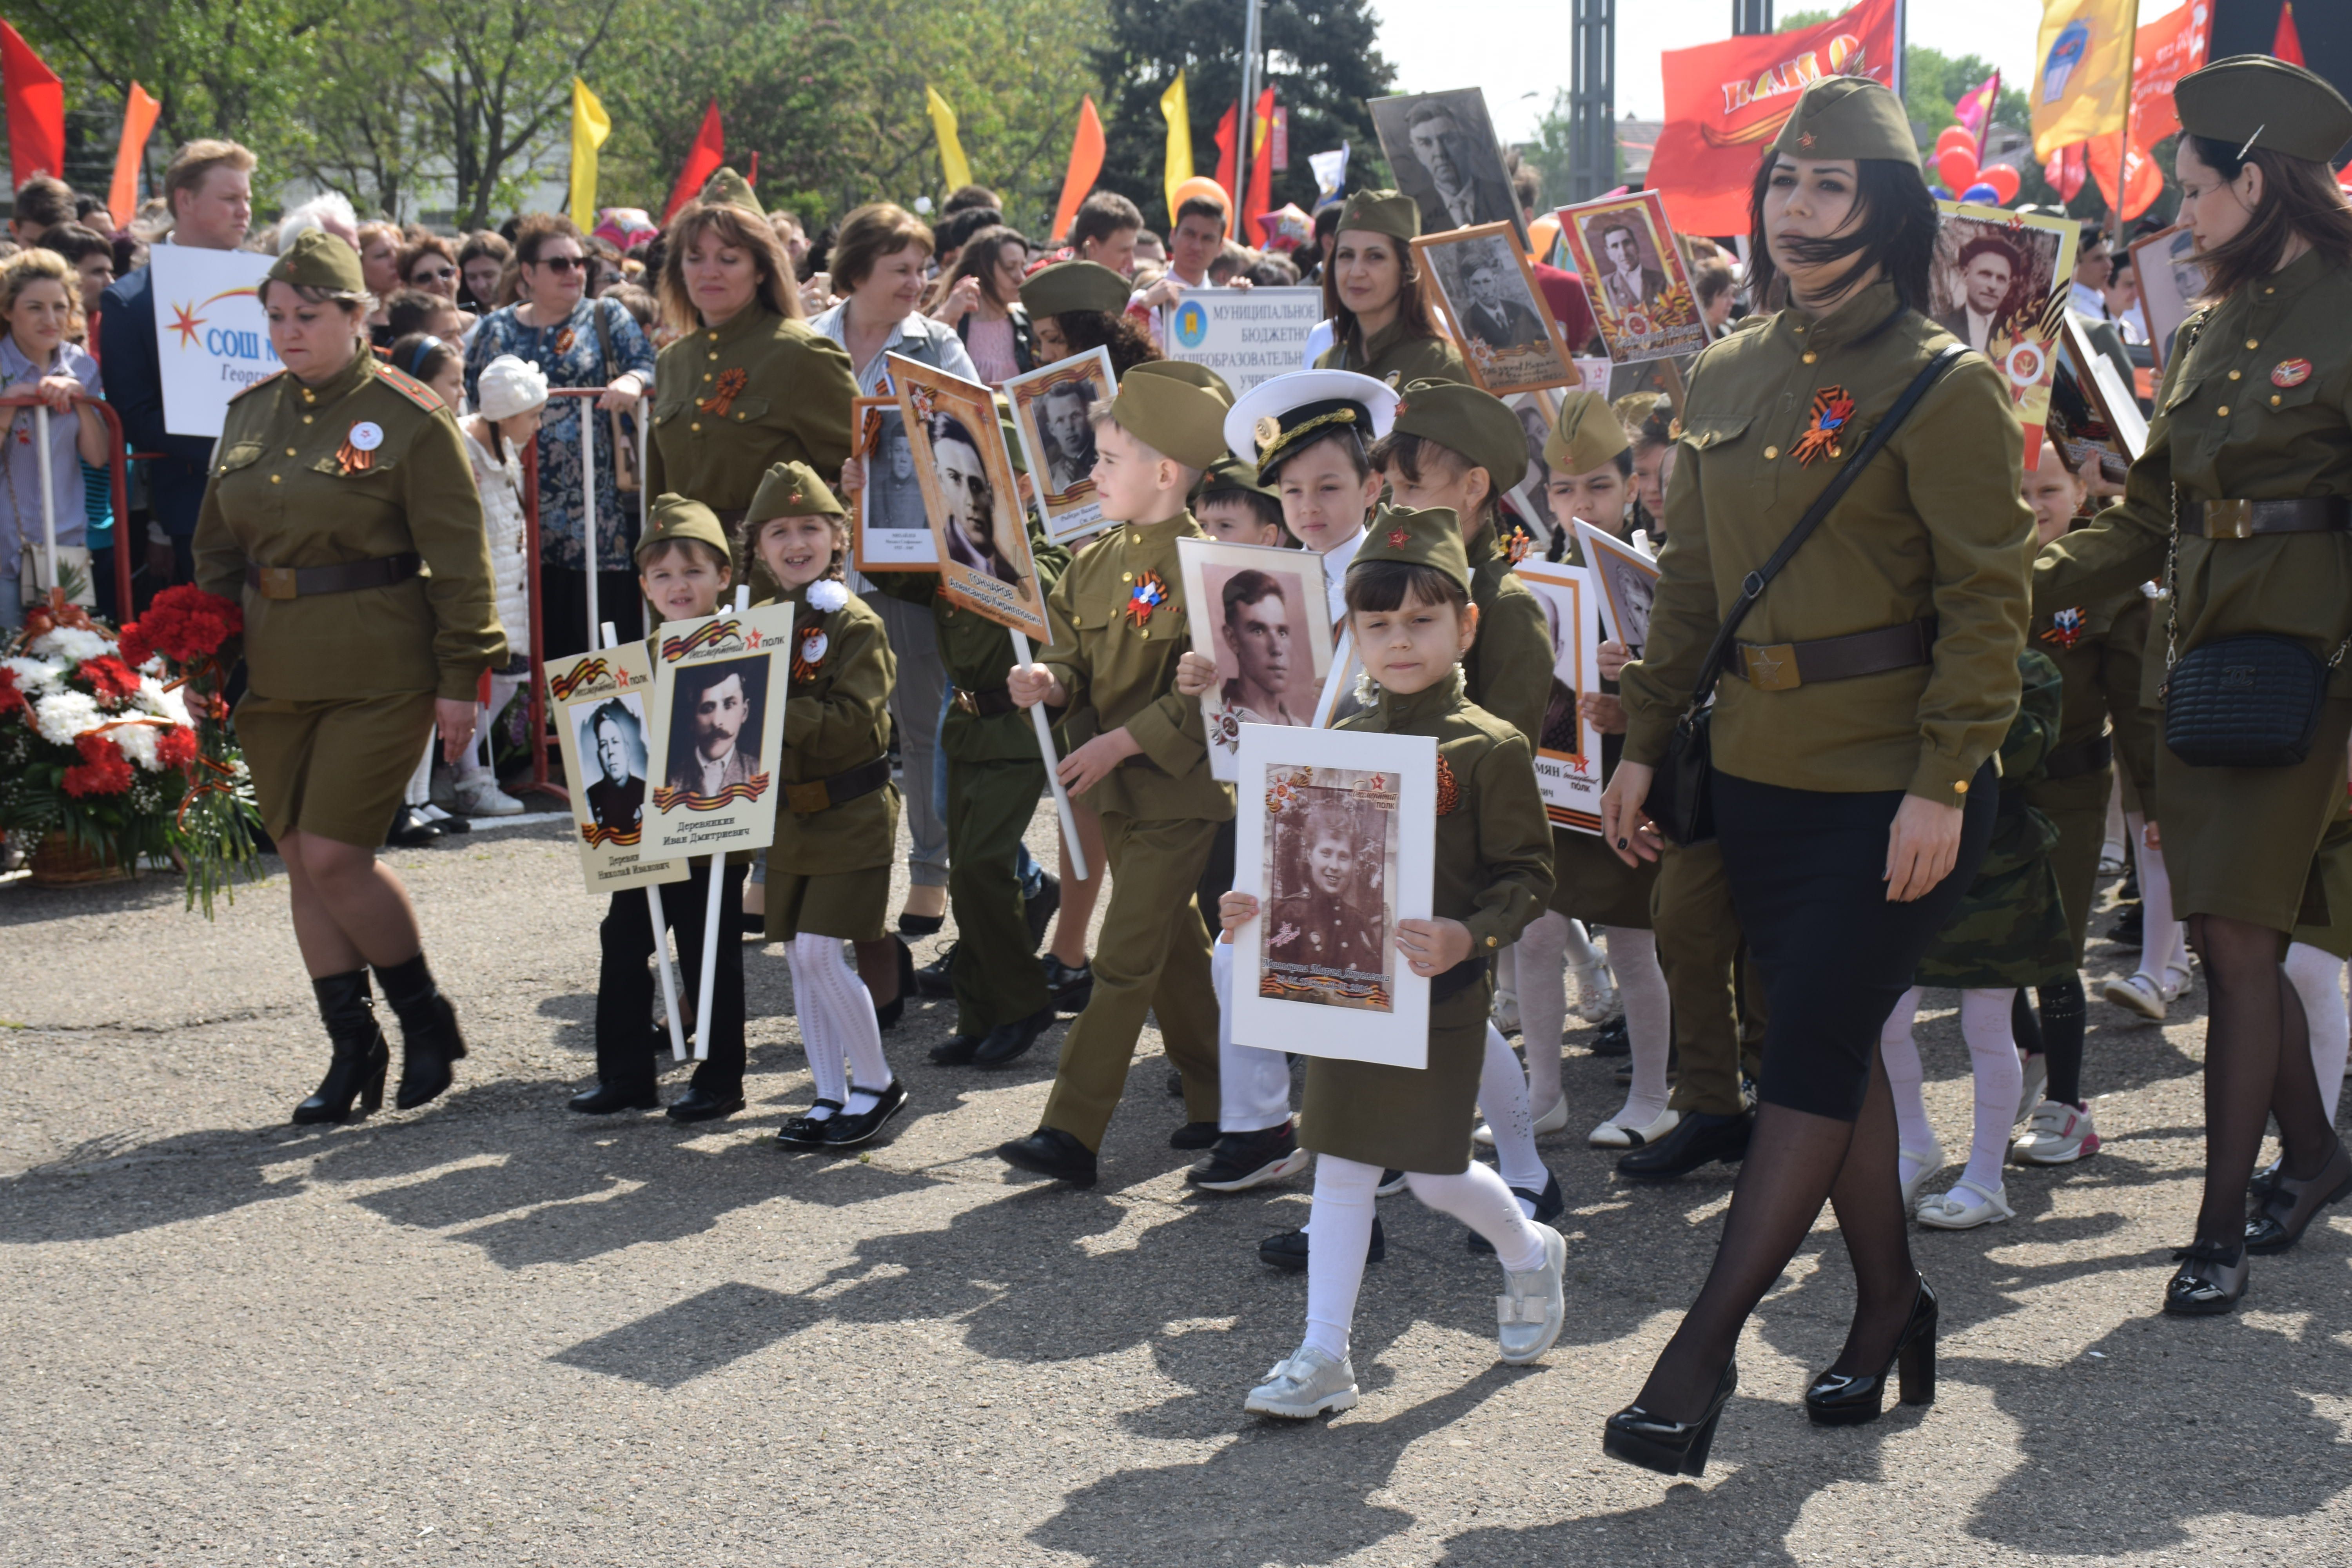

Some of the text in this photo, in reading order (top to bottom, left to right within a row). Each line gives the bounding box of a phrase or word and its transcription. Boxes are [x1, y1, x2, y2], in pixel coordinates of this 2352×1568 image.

[1214, 305, 1316, 320] МУНИЦИПАЛЬНОЕ
[207, 327, 259, 359] СОШ
[1241, 326, 1312, 343] БЮДЖЕТНО
[1173, 350, 1305, 367] ОБЩЕОБРАЗОВАТЕЛЬН
[1240, 373, 1279, 389] УЧРЕ
[967, 572, 1014, 601] ГОНЧАРОВ
[949, 576, 1042, 626] Александр Кириллович
[677, 817, 735, 833] Деревянкин
[663, 828, 750, 846] Иван Дмитриевич
[1310, 964, 1342, 978] Мария
[1341, 967, 1390, 982] Яковлевна
